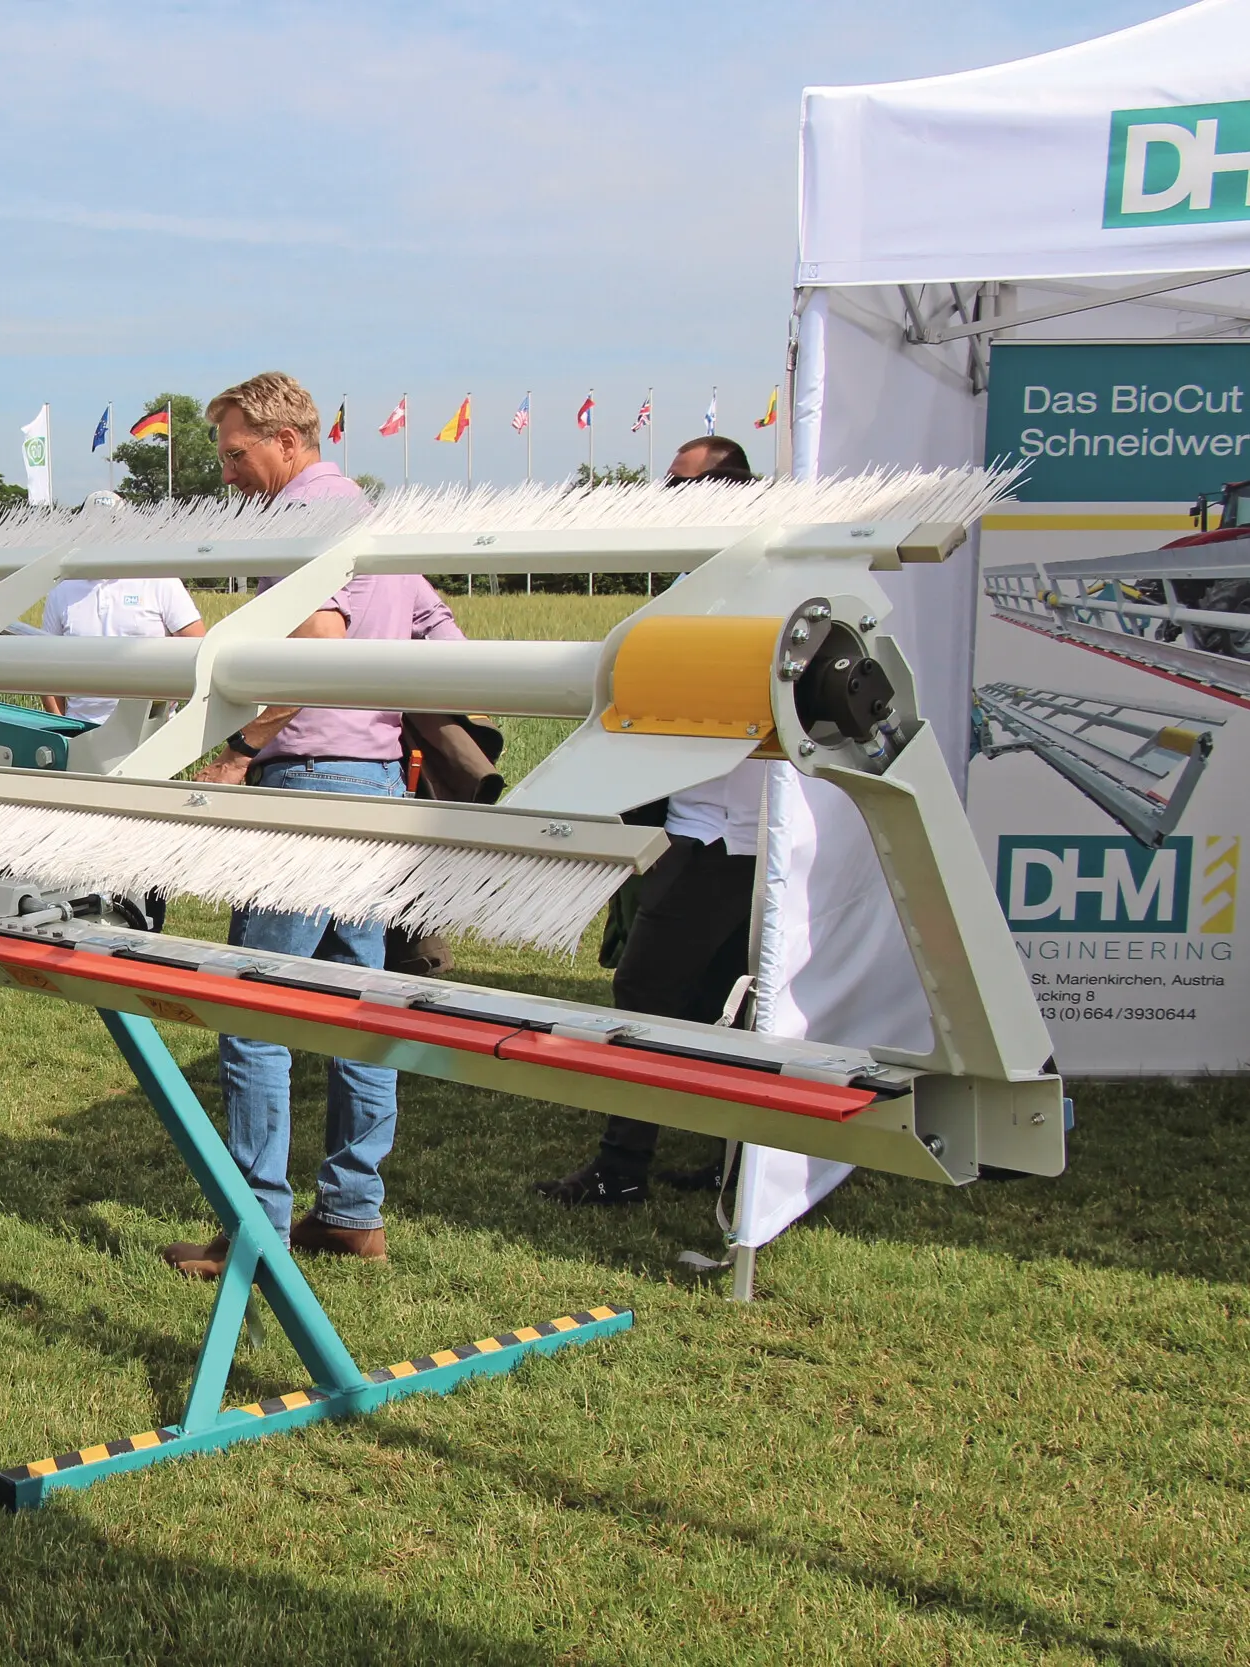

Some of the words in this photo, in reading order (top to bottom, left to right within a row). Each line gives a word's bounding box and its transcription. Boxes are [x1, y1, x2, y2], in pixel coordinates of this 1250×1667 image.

[1121, 119, 1250, 214] DH
[1023, 385, 1097, 414] Das
[1111, 384, 1244, 414] BioCut
[1019, 428, 1250, 457] Schneidwer
[1008, 848, 1178, 921] DHM
[1015, 940, 1233, 960] NGINEERING
[1031, 973, 1050, 985] St.
[1056, 973, 1167, 987] Marienkirchen,
[1171, 974, 1225, 986] Austria
[1035, 990, 1081, 1004] ucking
[1086, 990, 1095, 1002] 8
[1039, 1008, 1056, 1020] 43
